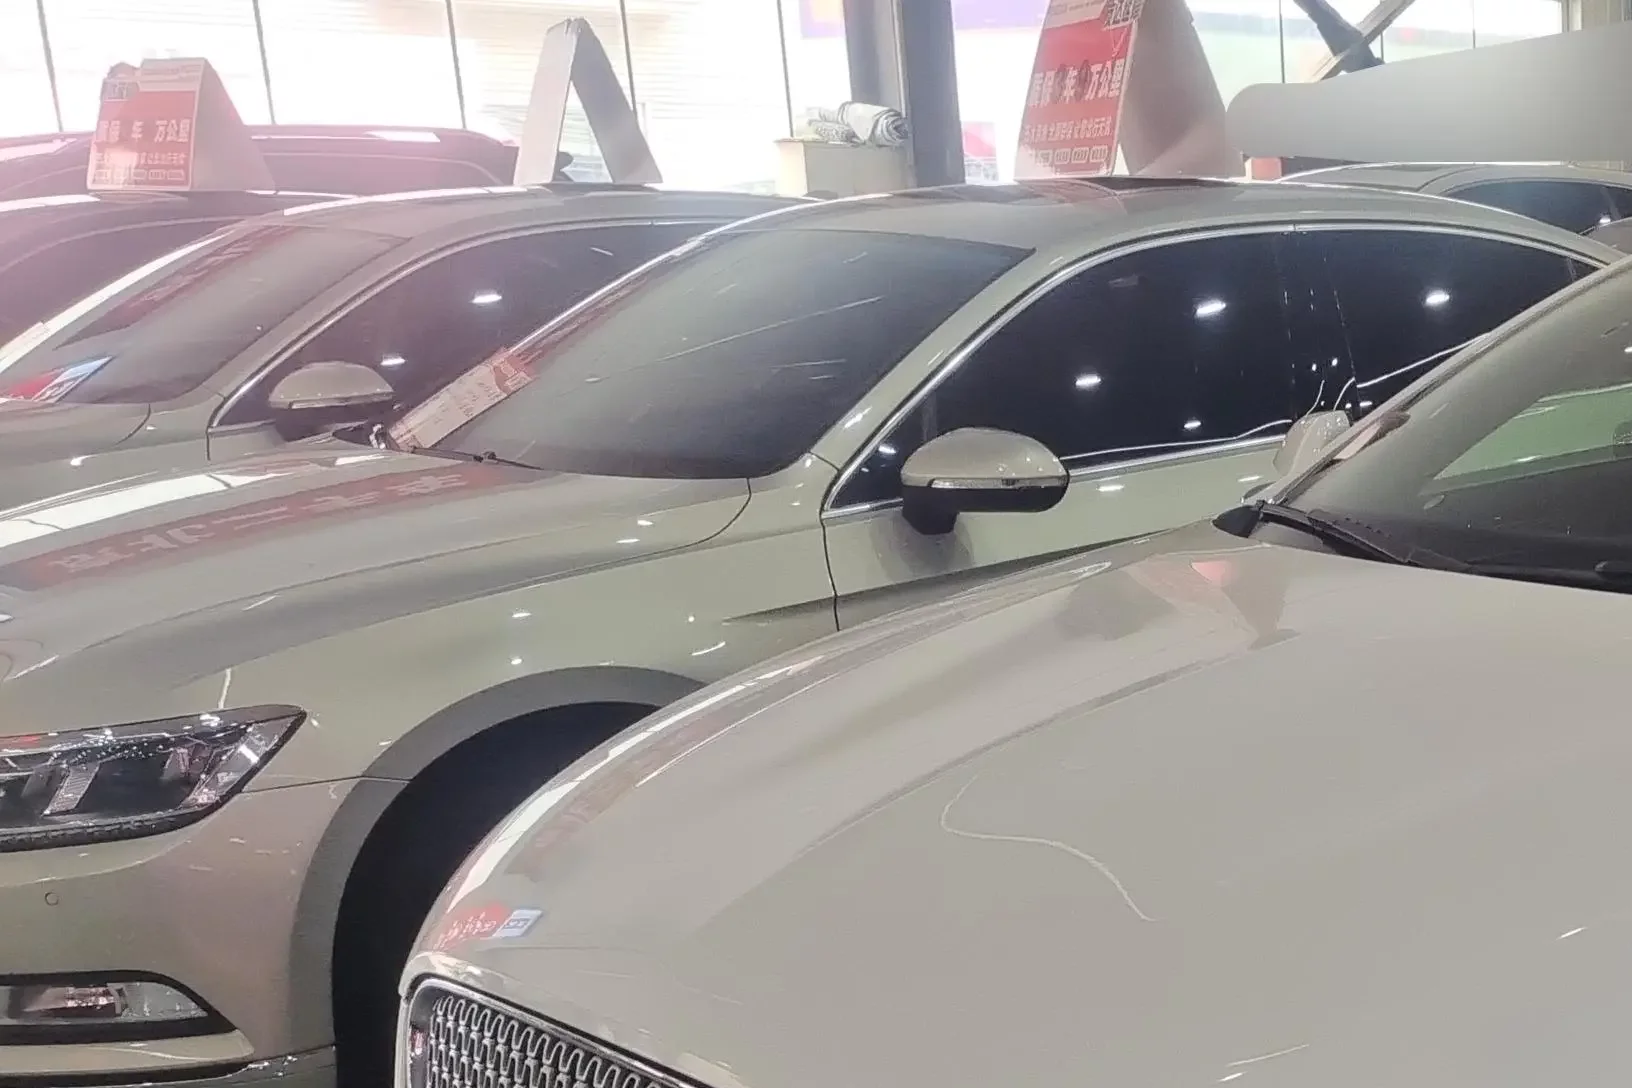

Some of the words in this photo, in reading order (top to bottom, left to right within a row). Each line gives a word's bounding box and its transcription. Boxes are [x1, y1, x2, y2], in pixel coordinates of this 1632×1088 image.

[1085, 58, 1125, 101] 万公里
[131, 120, 145, 142] 年
[154, 118, 190, 143] 万公里
